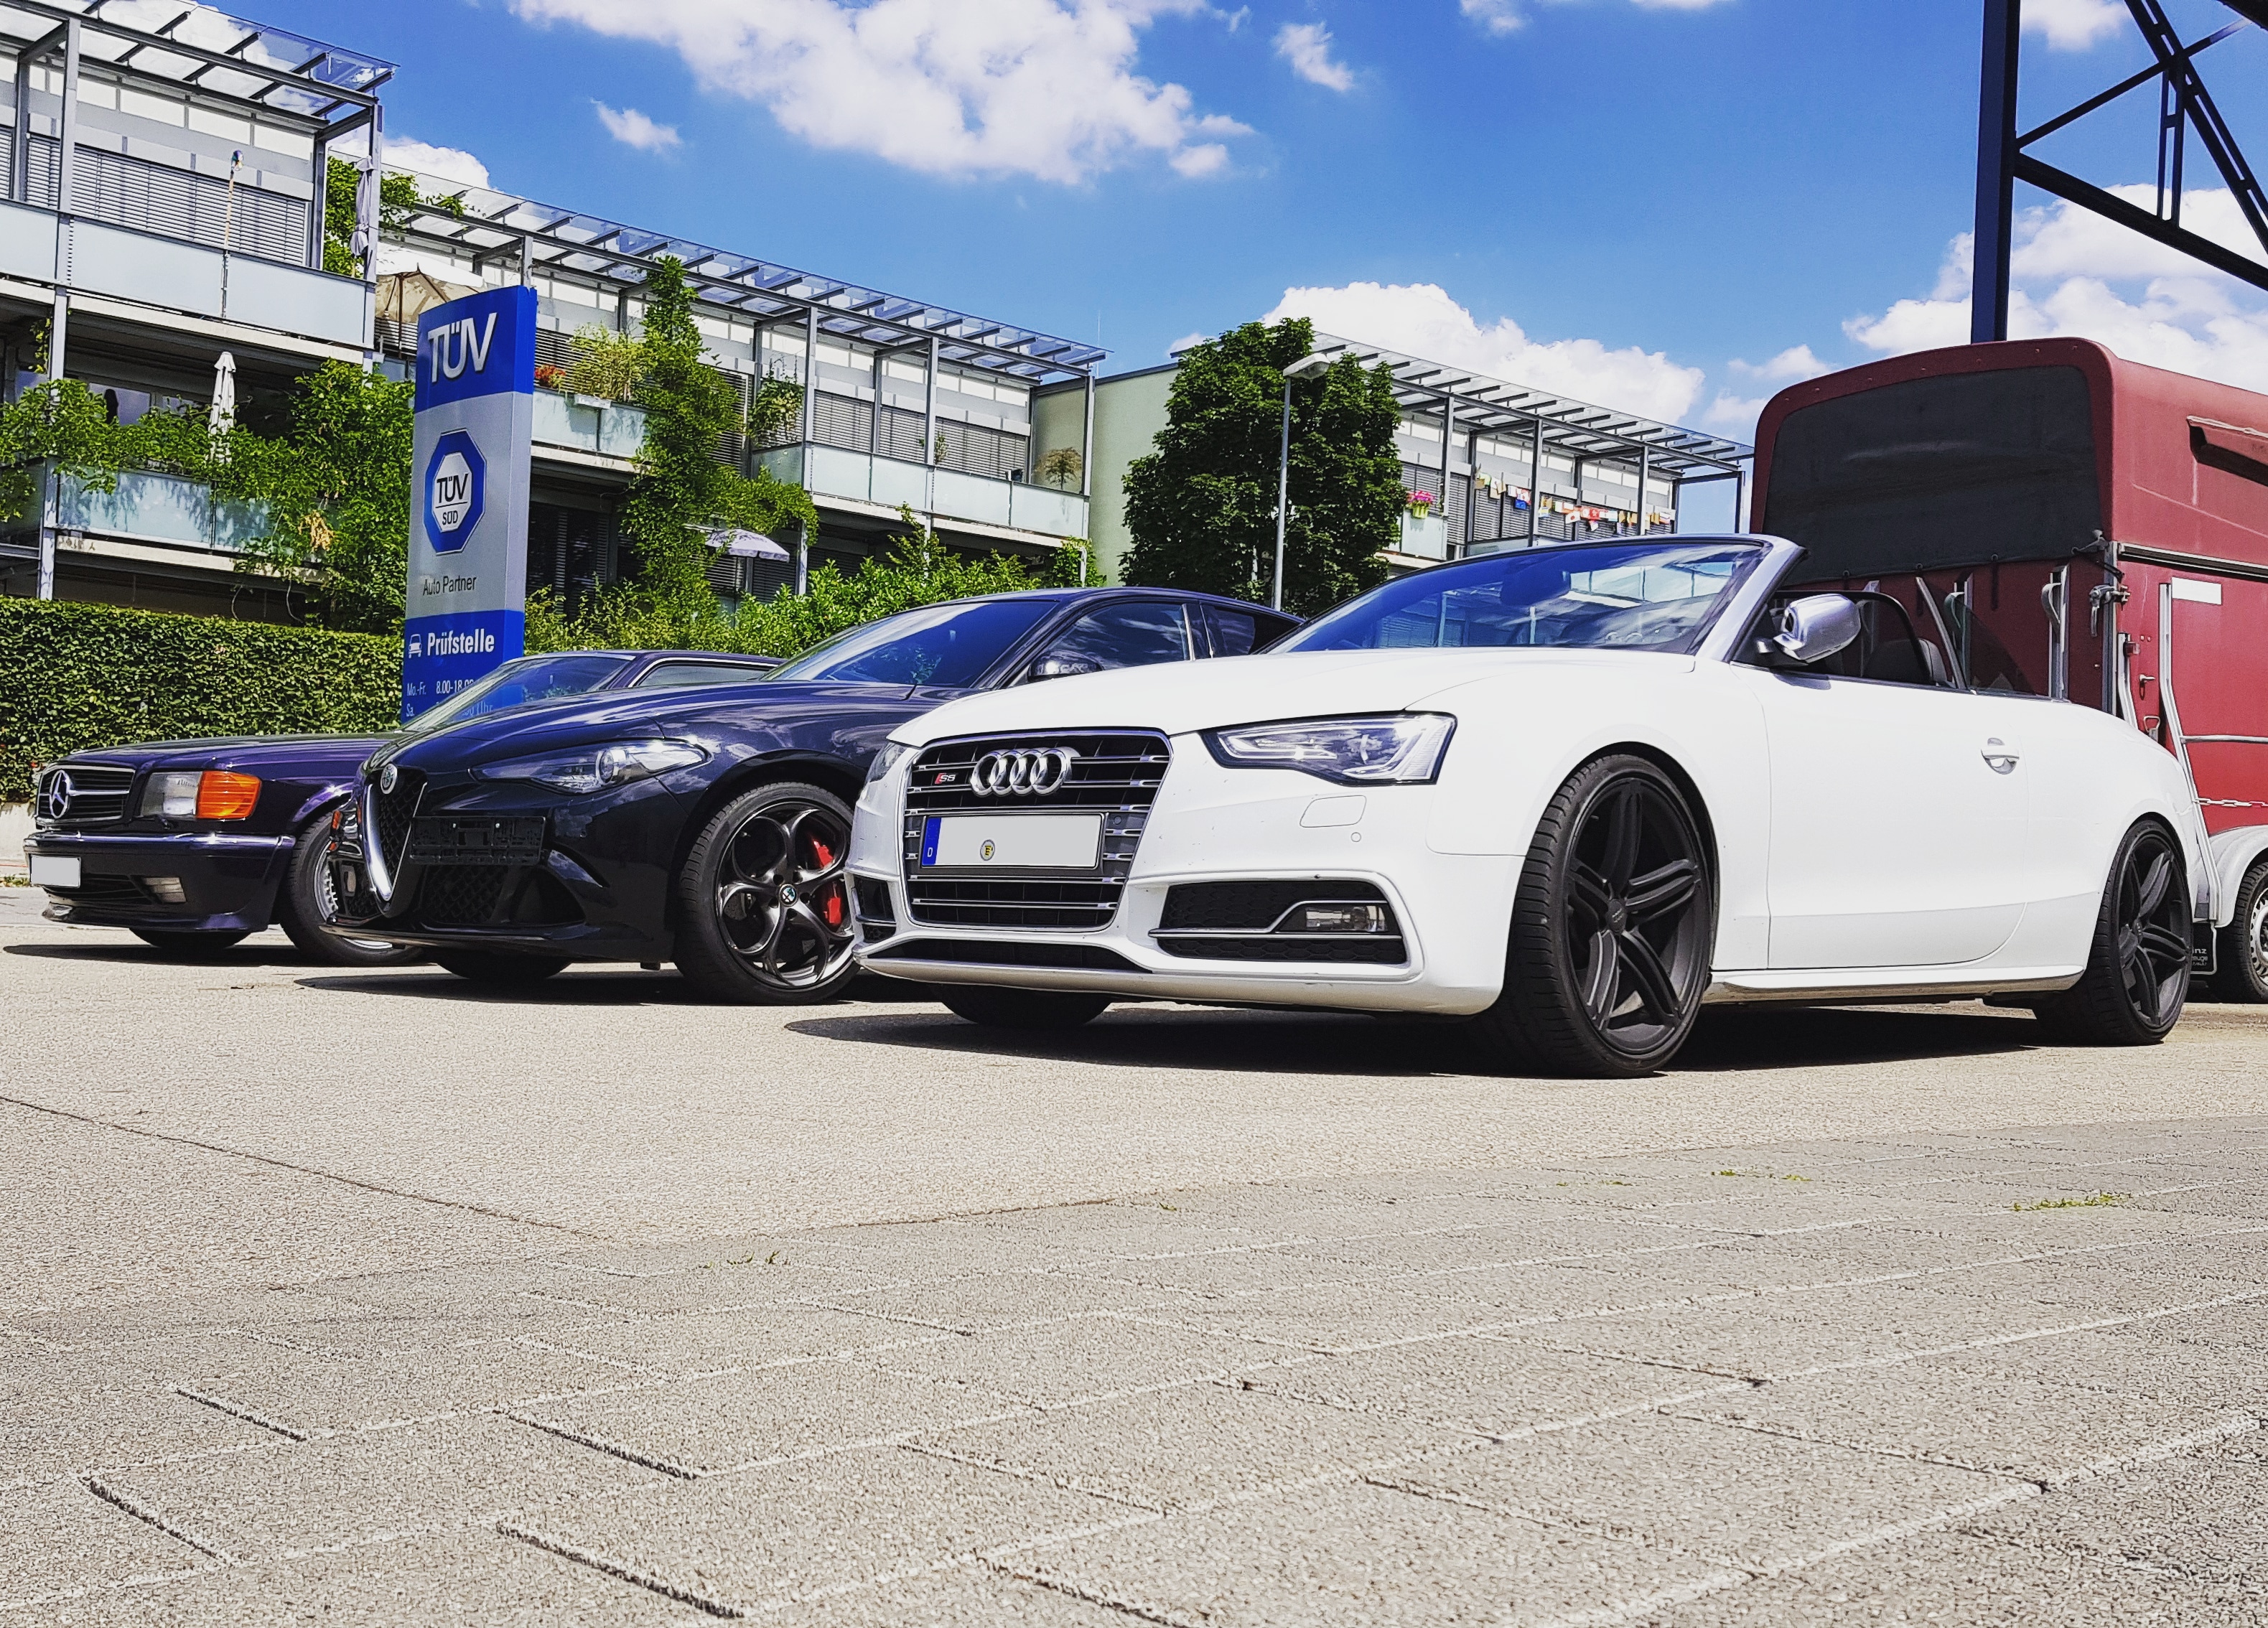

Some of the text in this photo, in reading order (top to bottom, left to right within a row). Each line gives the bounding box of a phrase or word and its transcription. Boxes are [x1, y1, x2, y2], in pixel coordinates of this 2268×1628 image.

[428, 312, 497, 383] TÜV
[437, 474, 468, 503] TÜV
[423, 576, 477, 596] Auto Partner
[427, 629, 495, 656] Prüfstelle
[406, 703, 415, 717] Sa.
[927, 847, 933, 858] D
